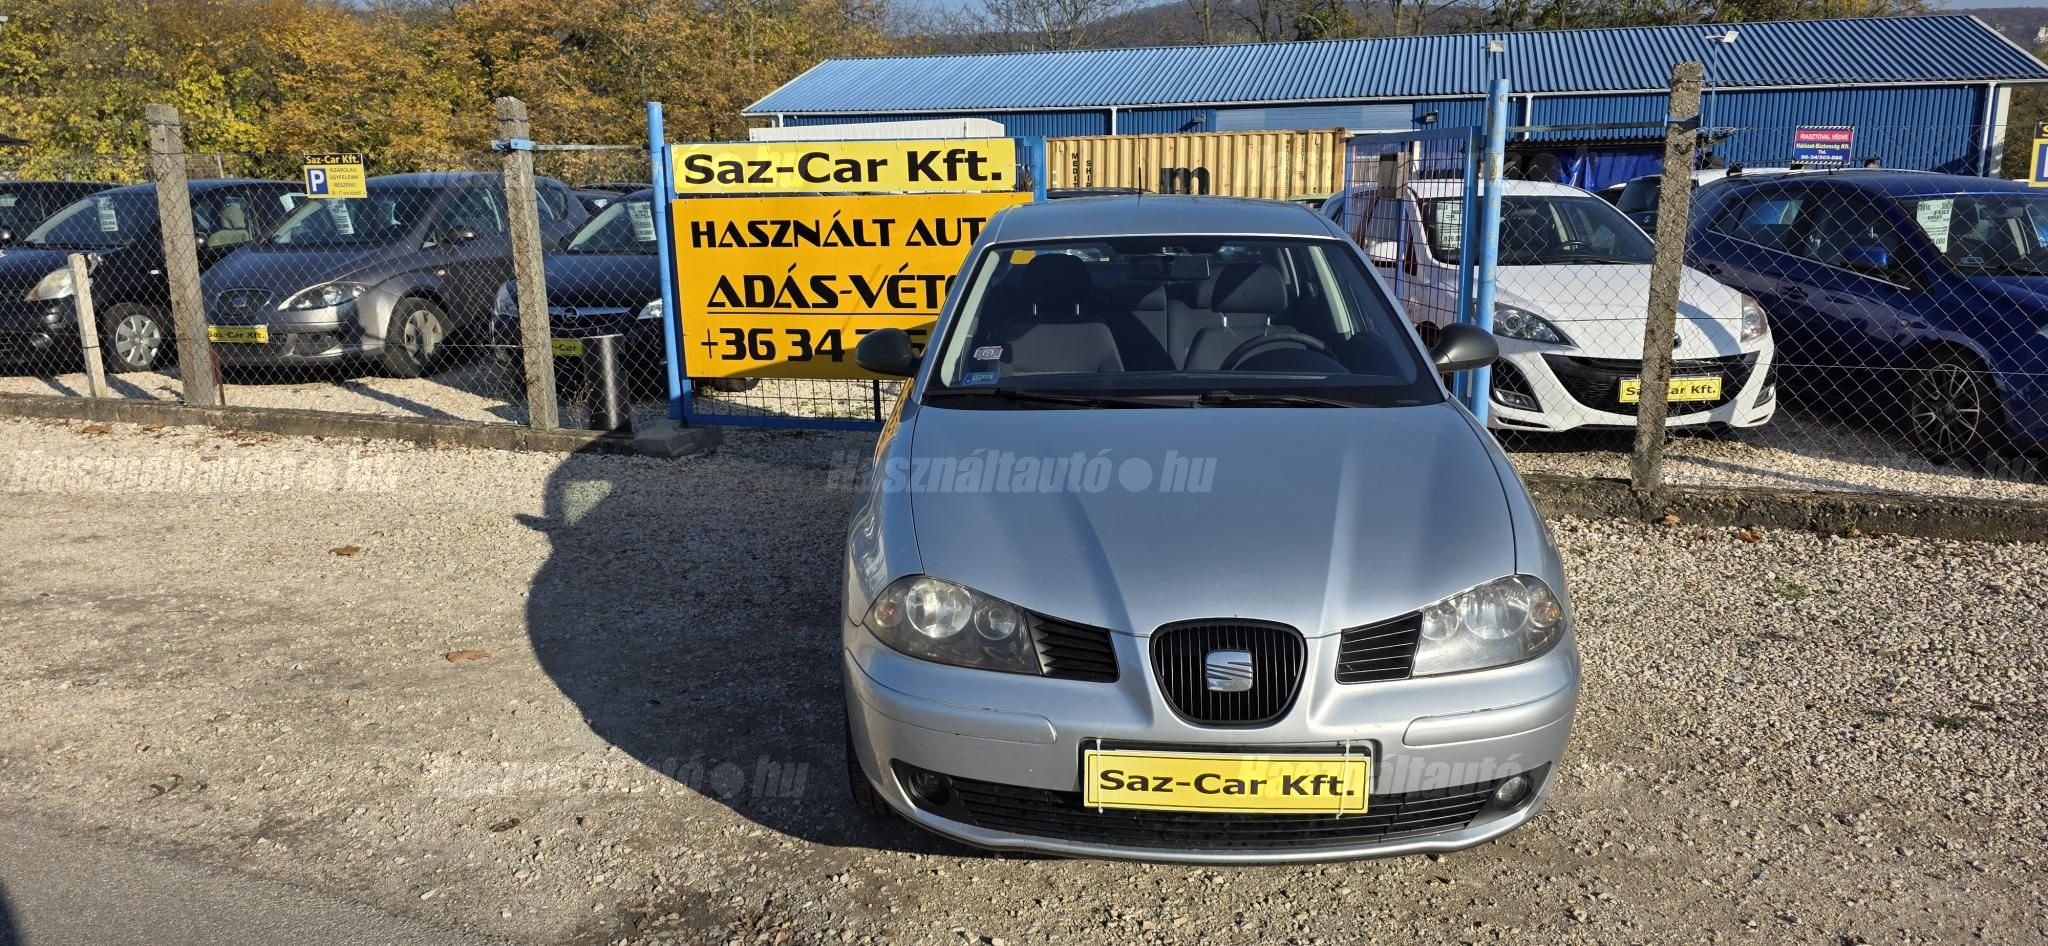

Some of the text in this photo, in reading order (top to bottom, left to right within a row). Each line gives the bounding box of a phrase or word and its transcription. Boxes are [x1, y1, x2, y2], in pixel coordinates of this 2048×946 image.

[306, 154, 360, 164] Saz-Car Kft.
[684, 152, 888, 184] Saz-Car
[907, 148, 1002, 182] Kft.
[691, 210, 896, 249] HASZNÁLT
[905, 217, 987, 246] AUT
[701, 328, 776, 361] +36
[785, 329, 845, 362] 34
[1691, 384, 1716, 394] Kft.
[1099, 769, 1355, 796] Saz-Car Kft.
